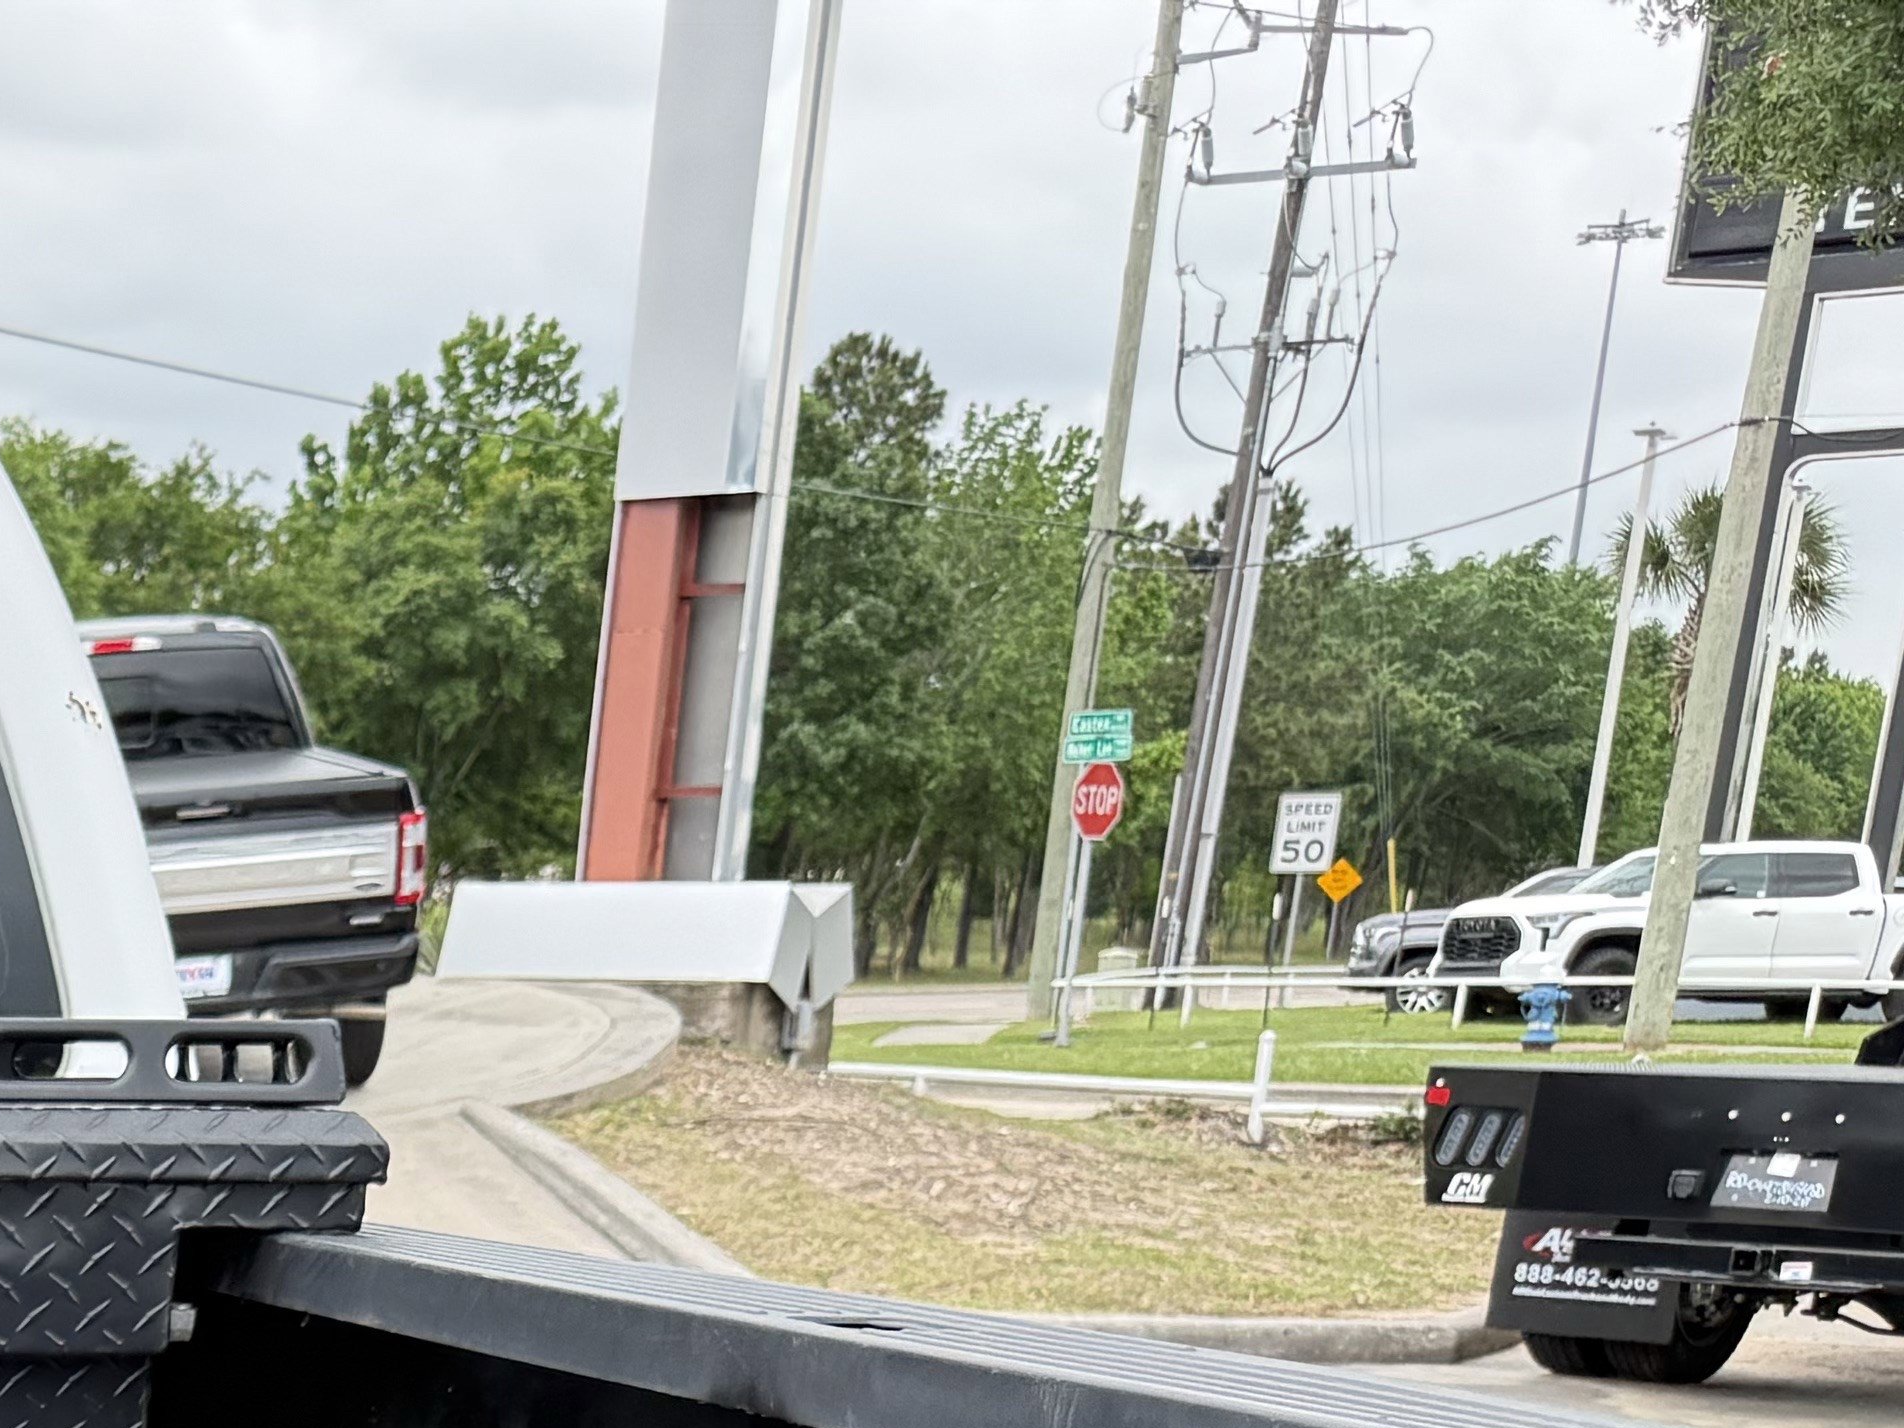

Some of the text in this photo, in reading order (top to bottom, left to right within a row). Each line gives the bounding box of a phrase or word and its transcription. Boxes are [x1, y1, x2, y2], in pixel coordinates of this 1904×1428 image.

[1075, 784, 1119, 816] STOP
[1285, 803, 1333, 816] SPEED
[1286, 820, 1326, 834] LIMIT
[1280, 839, 1324, 864] 50
